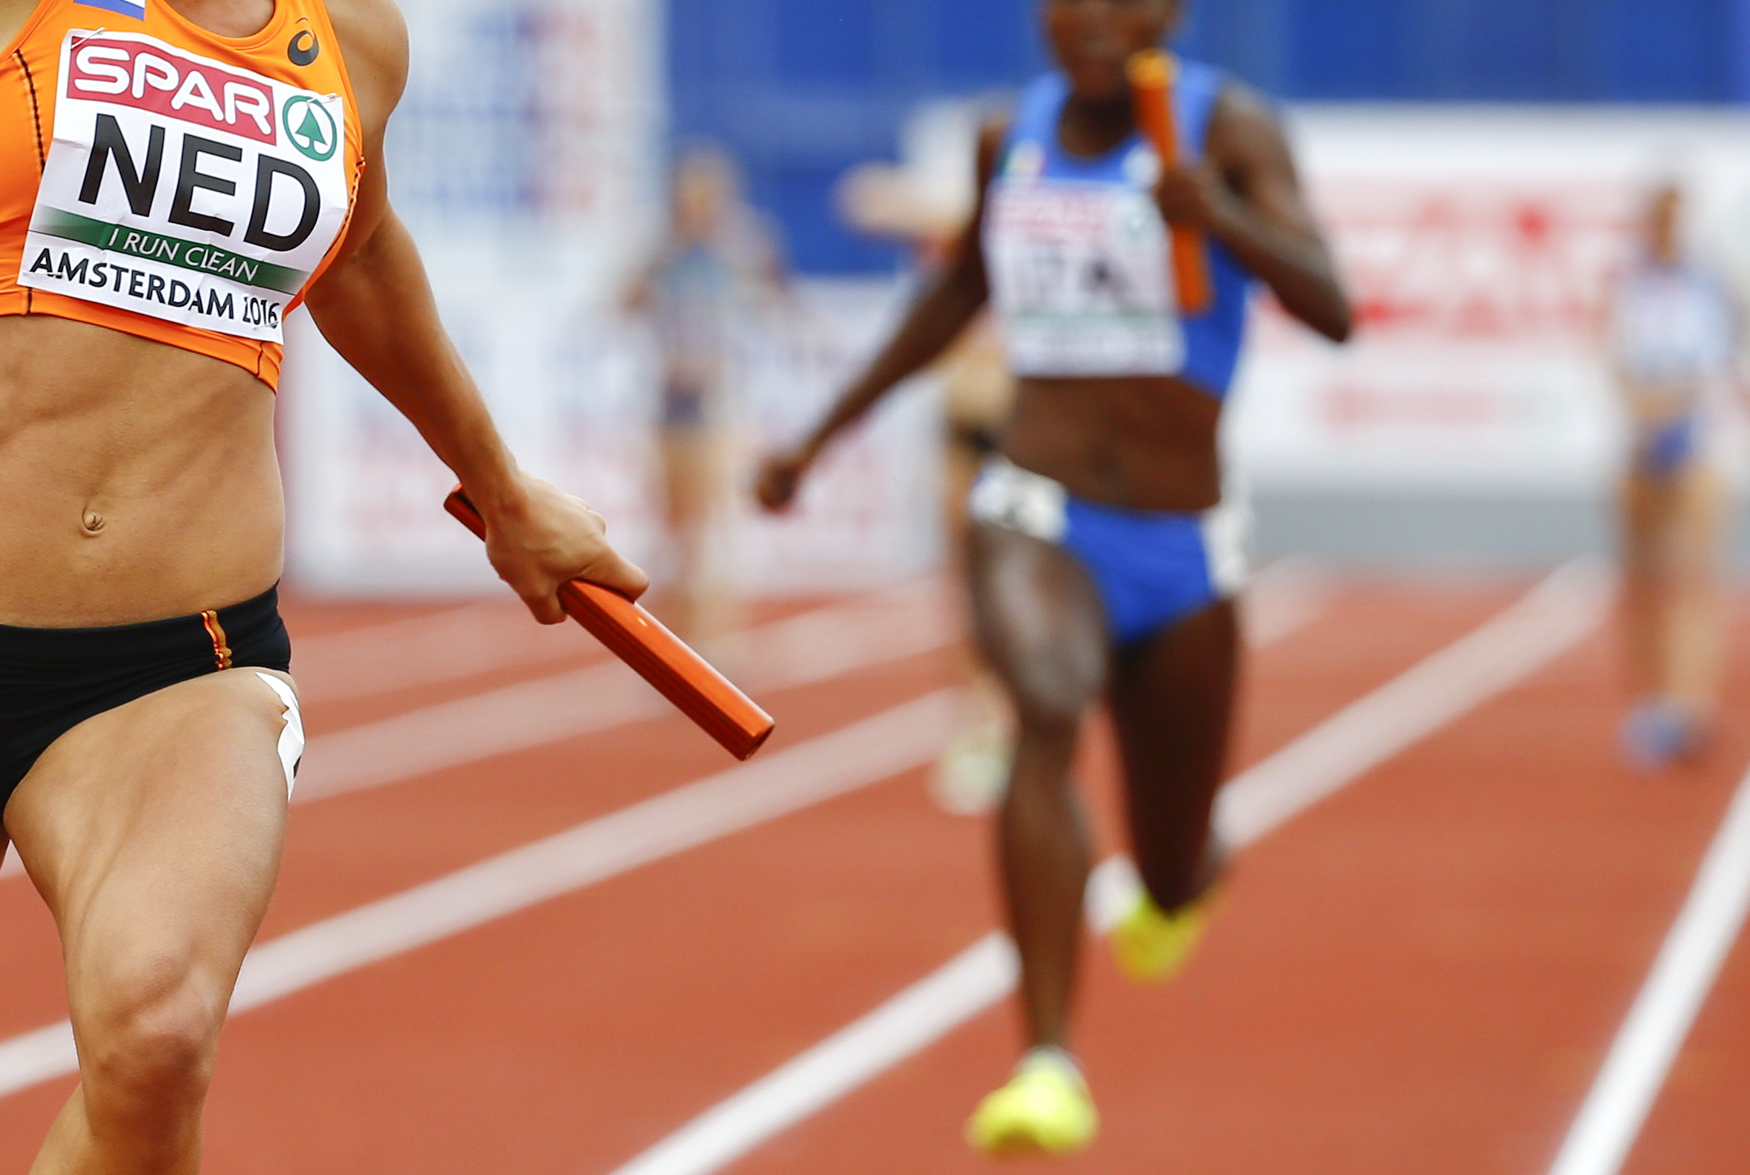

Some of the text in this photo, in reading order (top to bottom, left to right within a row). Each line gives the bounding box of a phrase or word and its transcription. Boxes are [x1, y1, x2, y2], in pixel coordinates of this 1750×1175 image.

[73, 45, 272, 135] SPAR
[77, 112, 322, 252] NED
[29, 247, 280, 330] AMSTERDAM 2016
[107, 228, 259, 282] I RUN CLEAN
